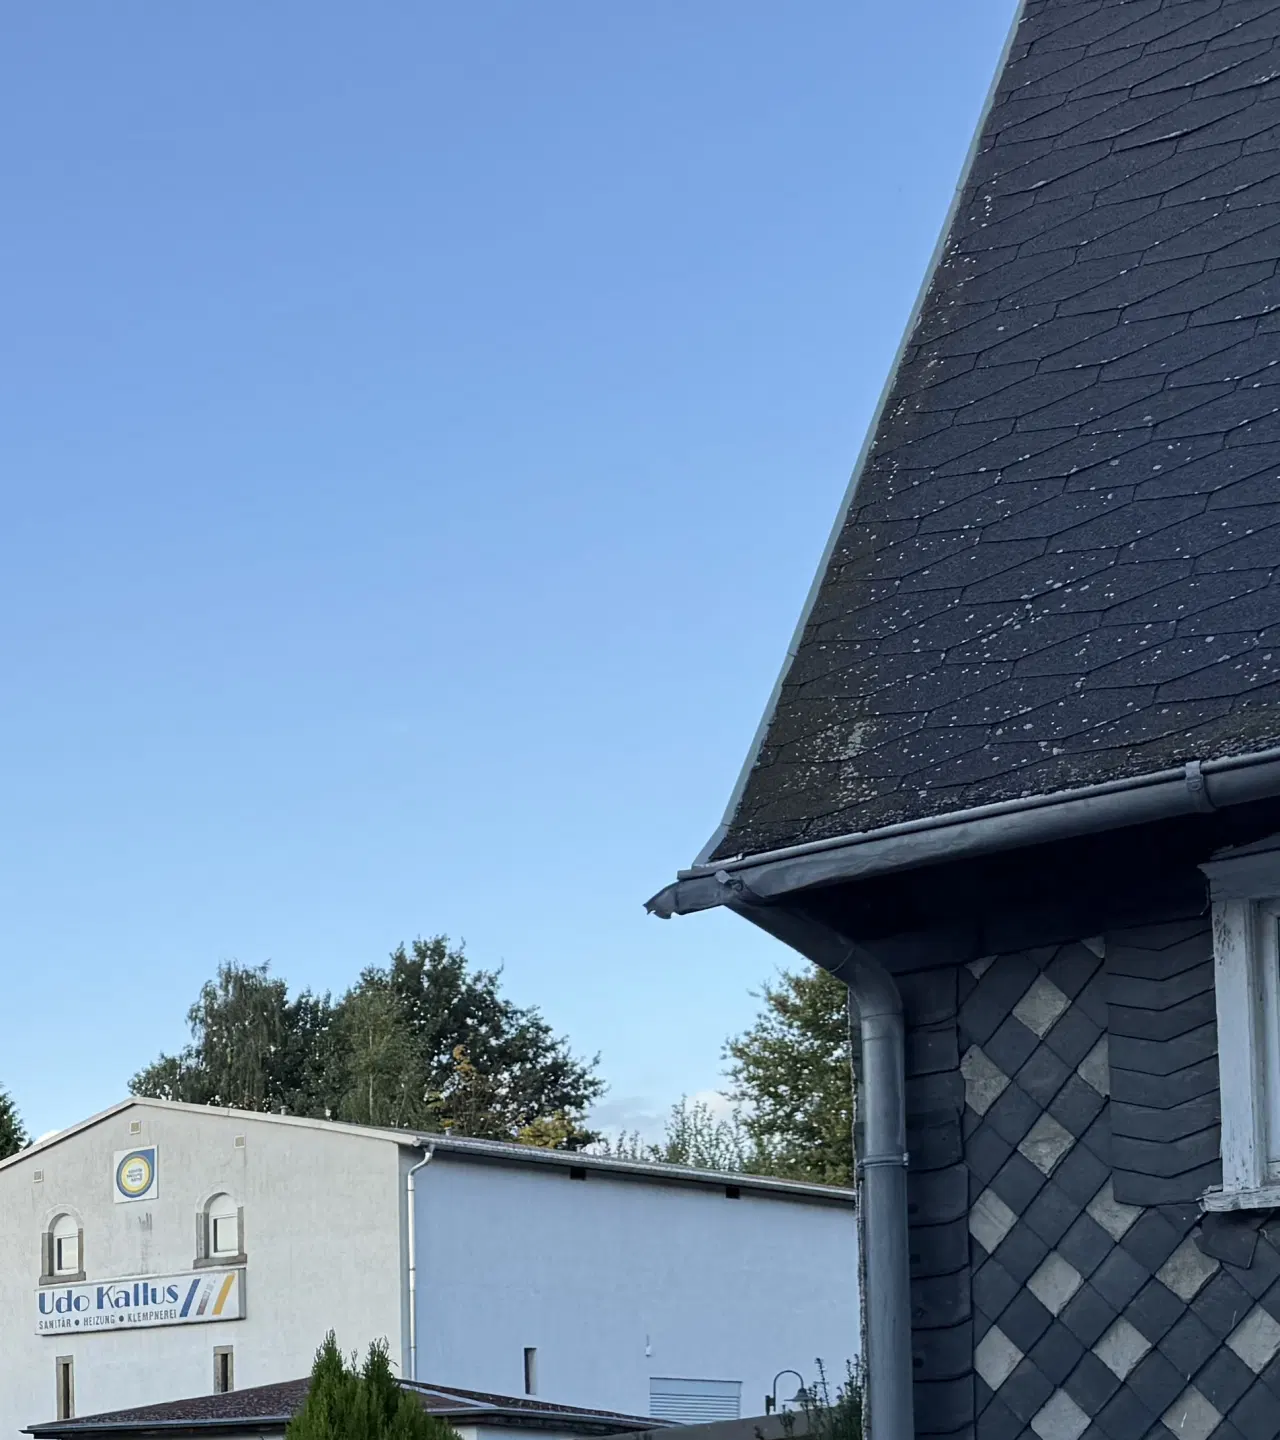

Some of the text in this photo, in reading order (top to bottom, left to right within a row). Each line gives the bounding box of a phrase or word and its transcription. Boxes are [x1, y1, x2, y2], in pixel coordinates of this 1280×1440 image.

[39, 1282, 179, 1315] Udo Kallus
[39, 1309, 177, 1330] SANITÄR HEIZUNG KLEMPNEREI
